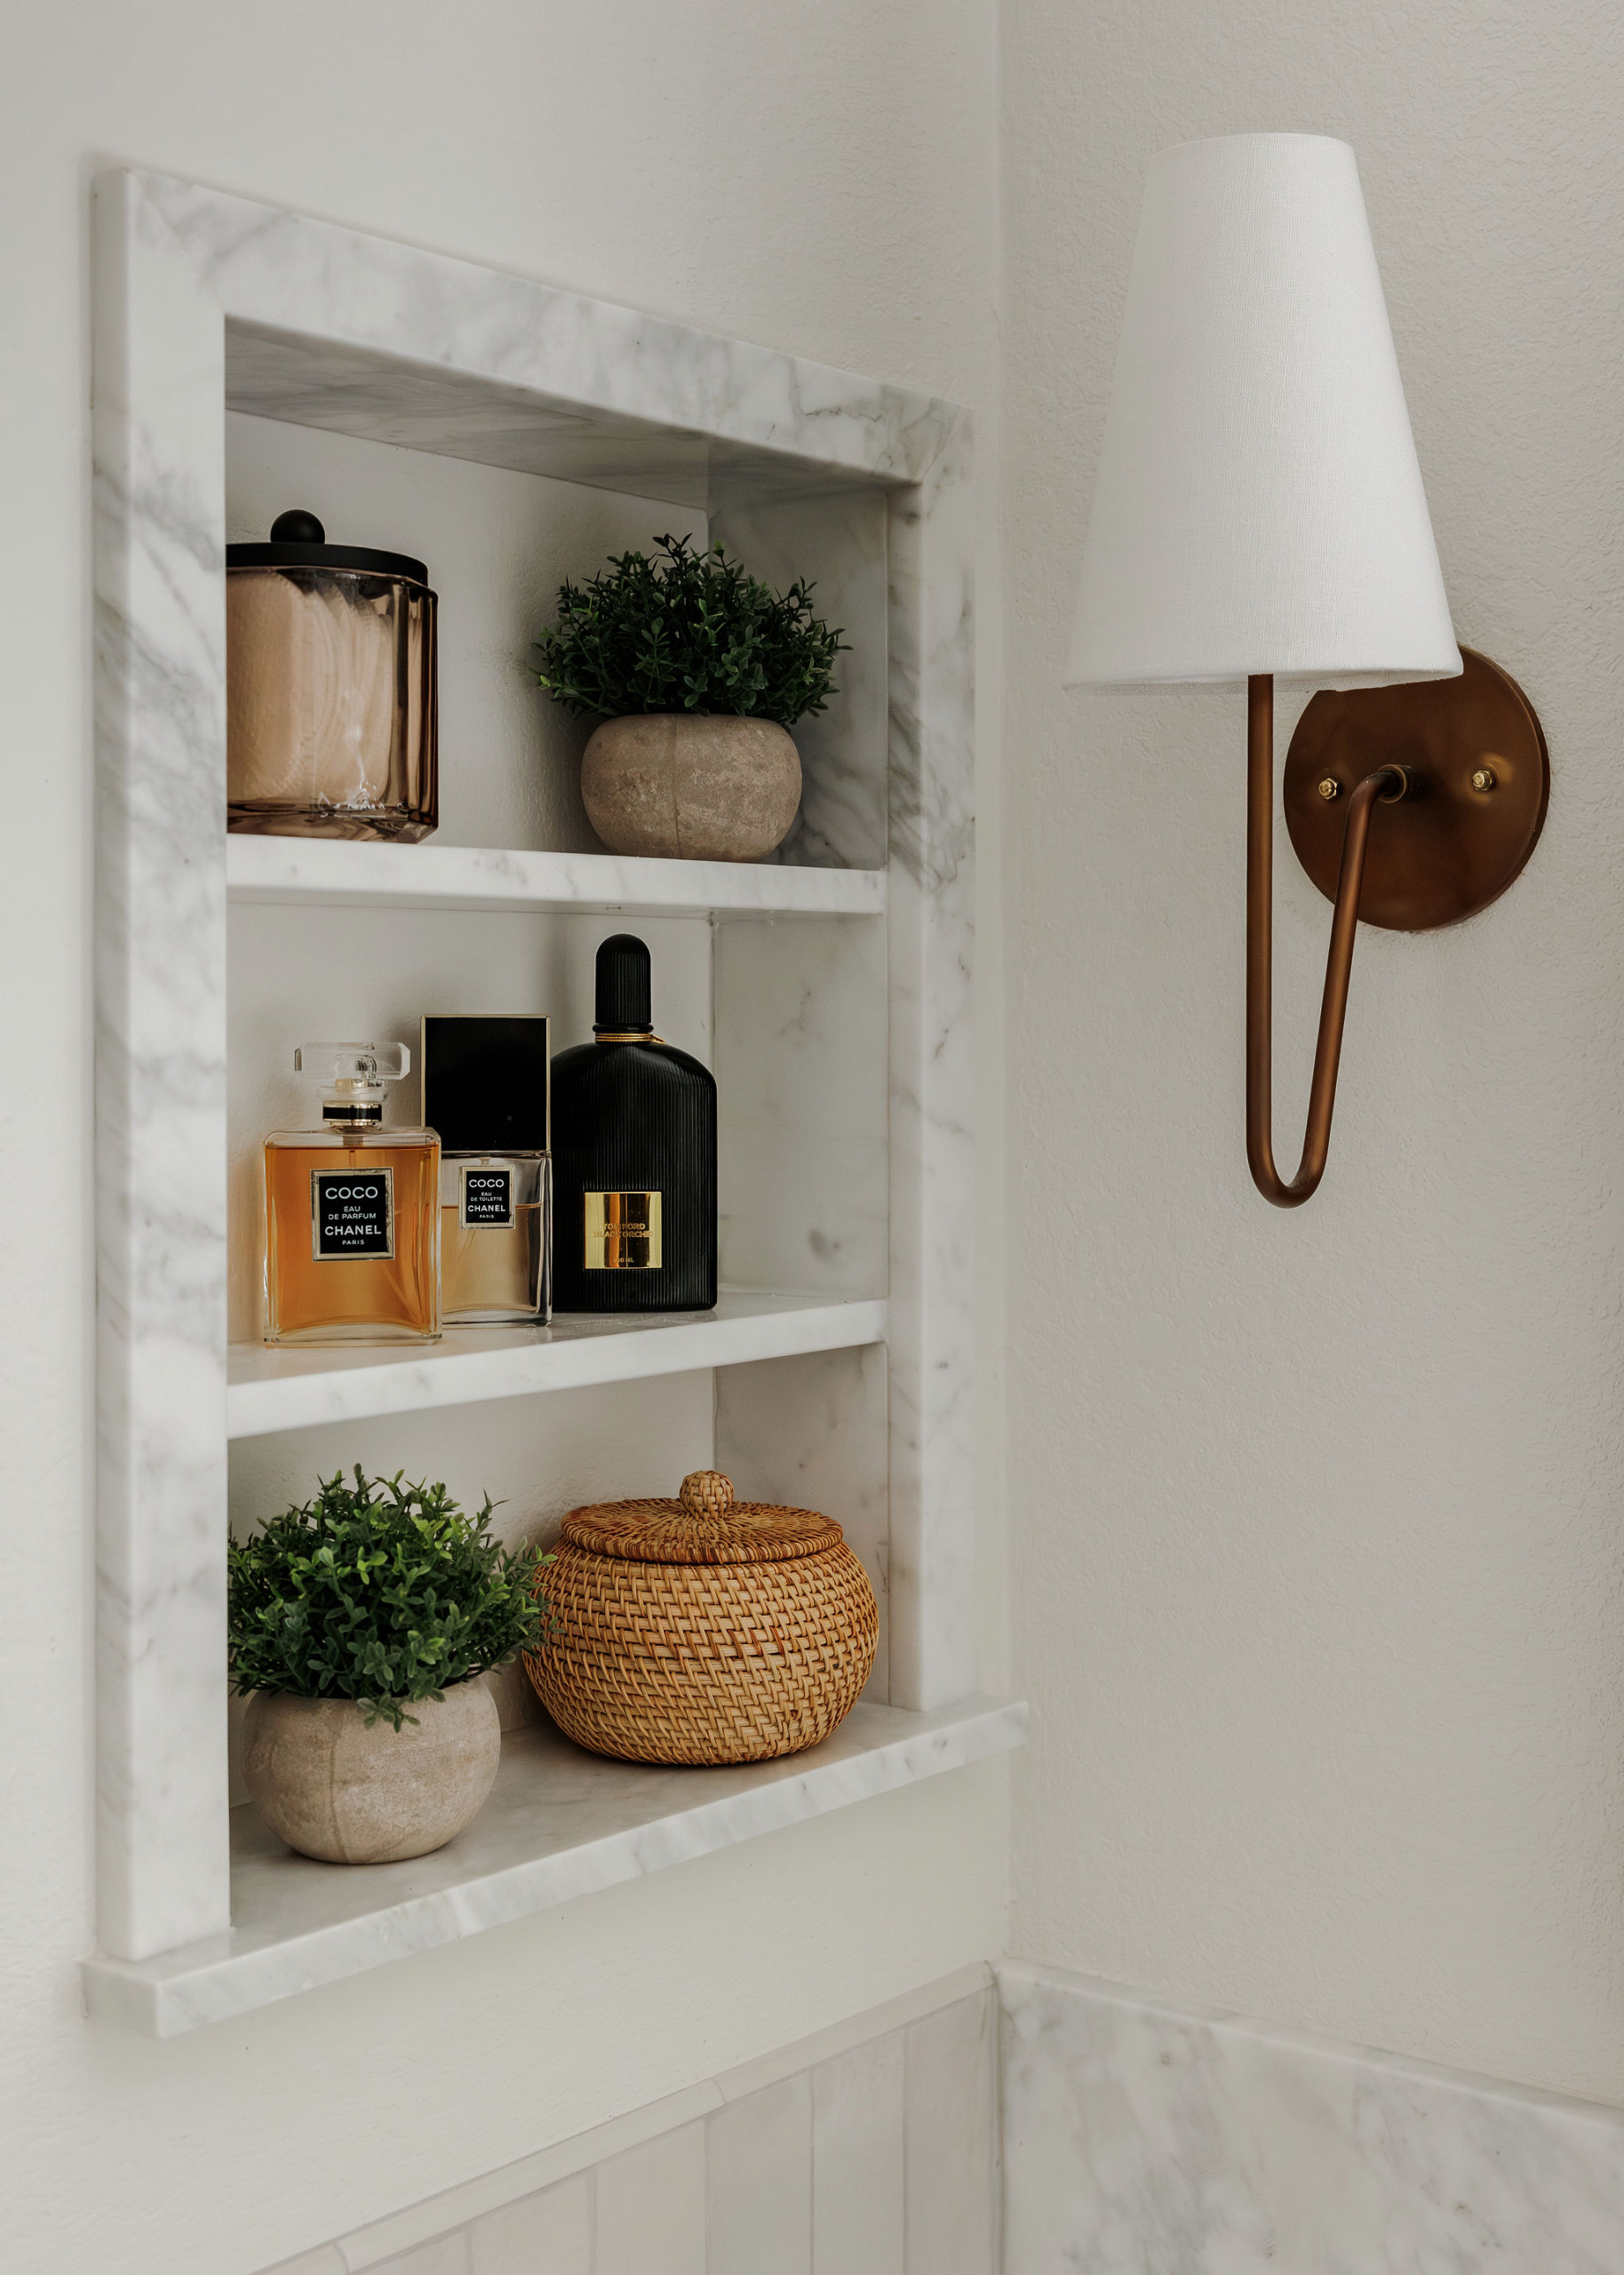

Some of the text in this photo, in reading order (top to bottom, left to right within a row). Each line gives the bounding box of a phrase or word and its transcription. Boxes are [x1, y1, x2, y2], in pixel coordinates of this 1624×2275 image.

[468, 1178, 505, 1188] COCO
[325, 1186, 378, 1200] COCO
[324, 1225, 382, 1236] CHANEL
